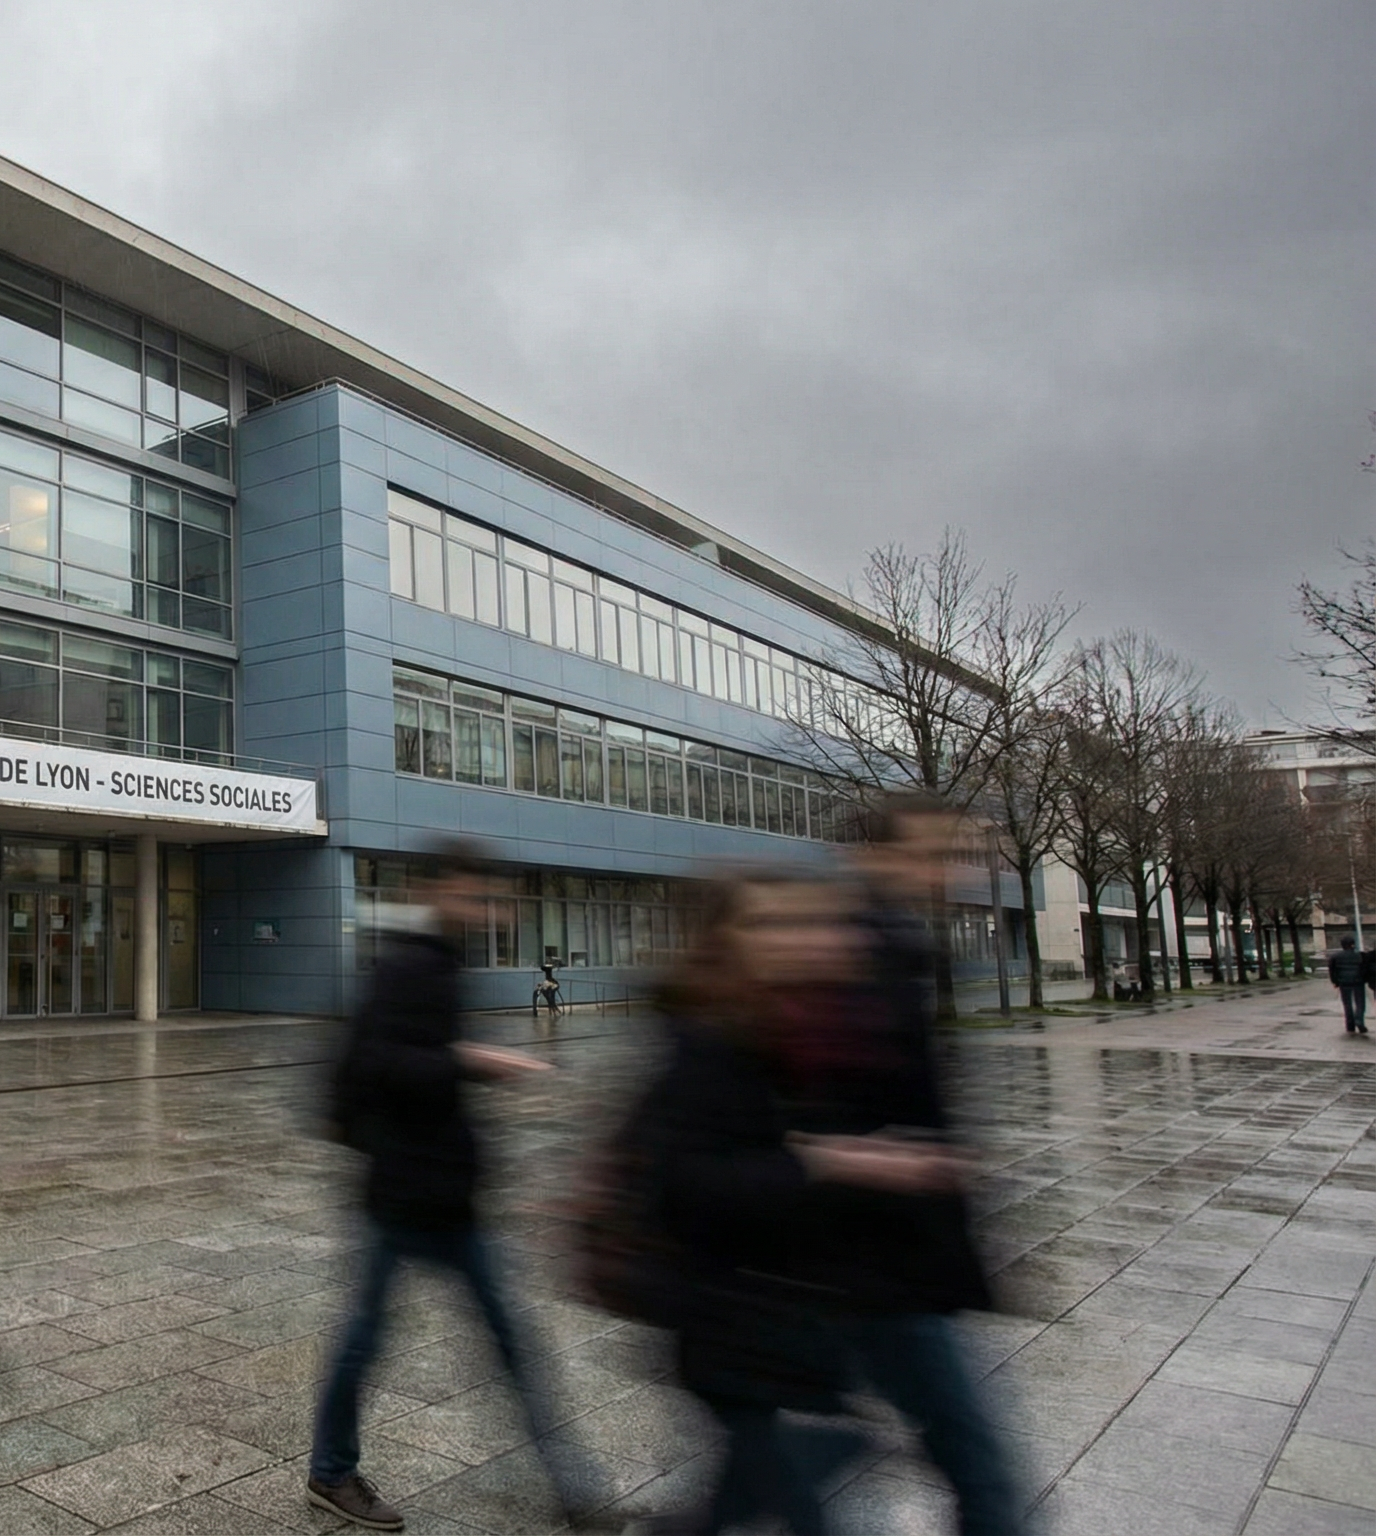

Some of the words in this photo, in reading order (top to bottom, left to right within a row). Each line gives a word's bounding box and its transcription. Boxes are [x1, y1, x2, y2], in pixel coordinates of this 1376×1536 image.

[0, 757, 29, 785] DE
[35, 761, 90, 792] LYON
[110, 771, 205, 805] SCIENCES
[209, 783, 292, 814] SOCIALES
